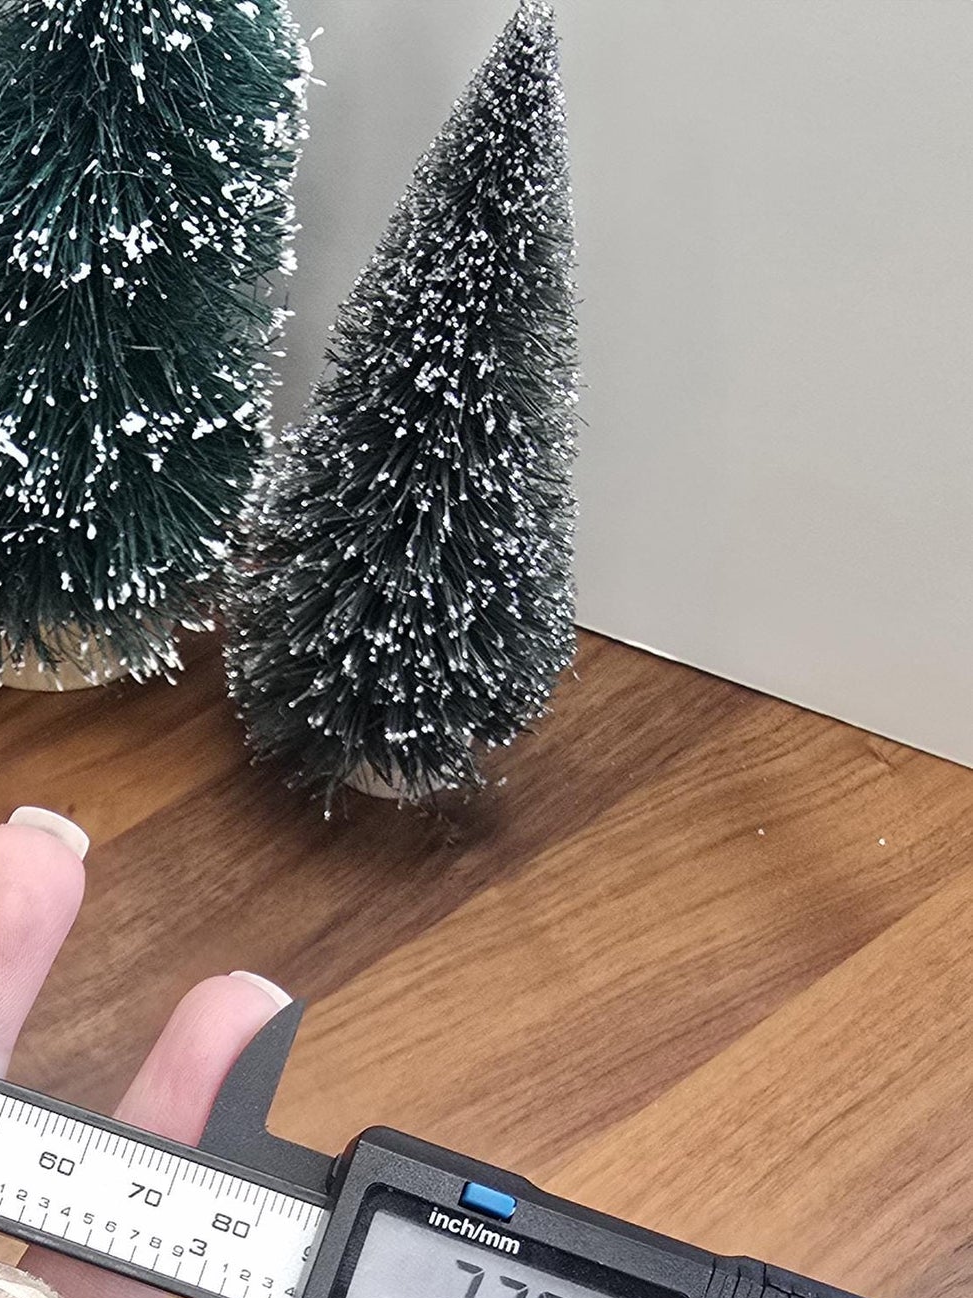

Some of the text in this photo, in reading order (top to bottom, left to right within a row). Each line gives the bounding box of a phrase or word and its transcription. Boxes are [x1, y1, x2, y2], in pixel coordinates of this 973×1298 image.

[0, 1183, 6, 1193] 1
[16, 1189, 28, 1201] 2
[38, 1197, 51, 1209] 3
[60, 1206, 71, 1217] 4
[82, 1213, 95, 1225] 5
[105, 1221, 117, 1233] 6
[129, 1229, 140, 1240] 7
[149, 1236, 162, 1249] 8
[171, 1245, 184, 1258] 9
[189, 1238, 208, 1257] 3
[223, 1263, 229, 1273] 1
[239, 1269, 252, 1282] 2
[262, 1277, 275, 1289] 3
[38, 1151, 75, 1176] 60
[128, 1182, 163, 1207] 70
[211, 1212, 250, 1239] 80
[428, 1207, 521, 1255] inch/mm
